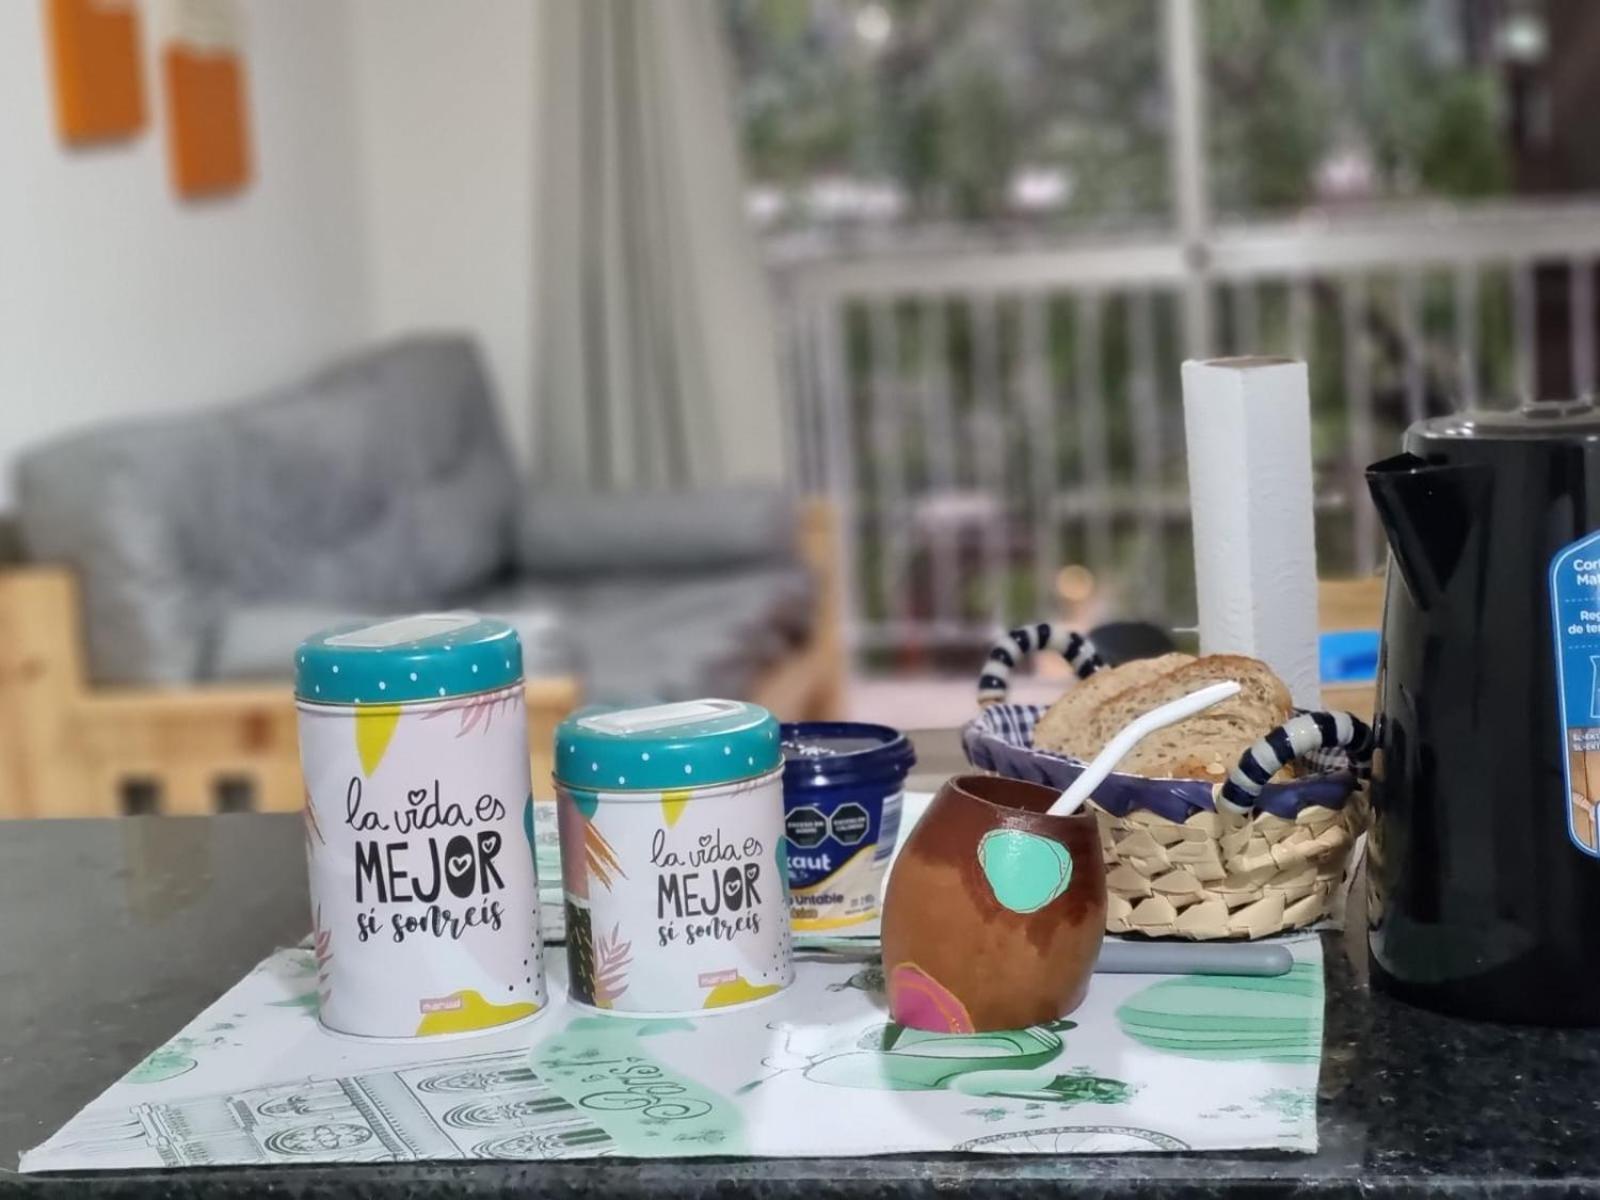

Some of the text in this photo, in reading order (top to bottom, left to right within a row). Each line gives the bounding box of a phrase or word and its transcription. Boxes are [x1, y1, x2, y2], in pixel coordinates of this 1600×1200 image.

[1568, 624, 1584, 635] de
[345, 776, 506, 834] la vida es
[355, 831, 505, 903] MEJOR
[650, 827, 764, 867] la vida es
[657, 863, 762, 919] MEJOR
